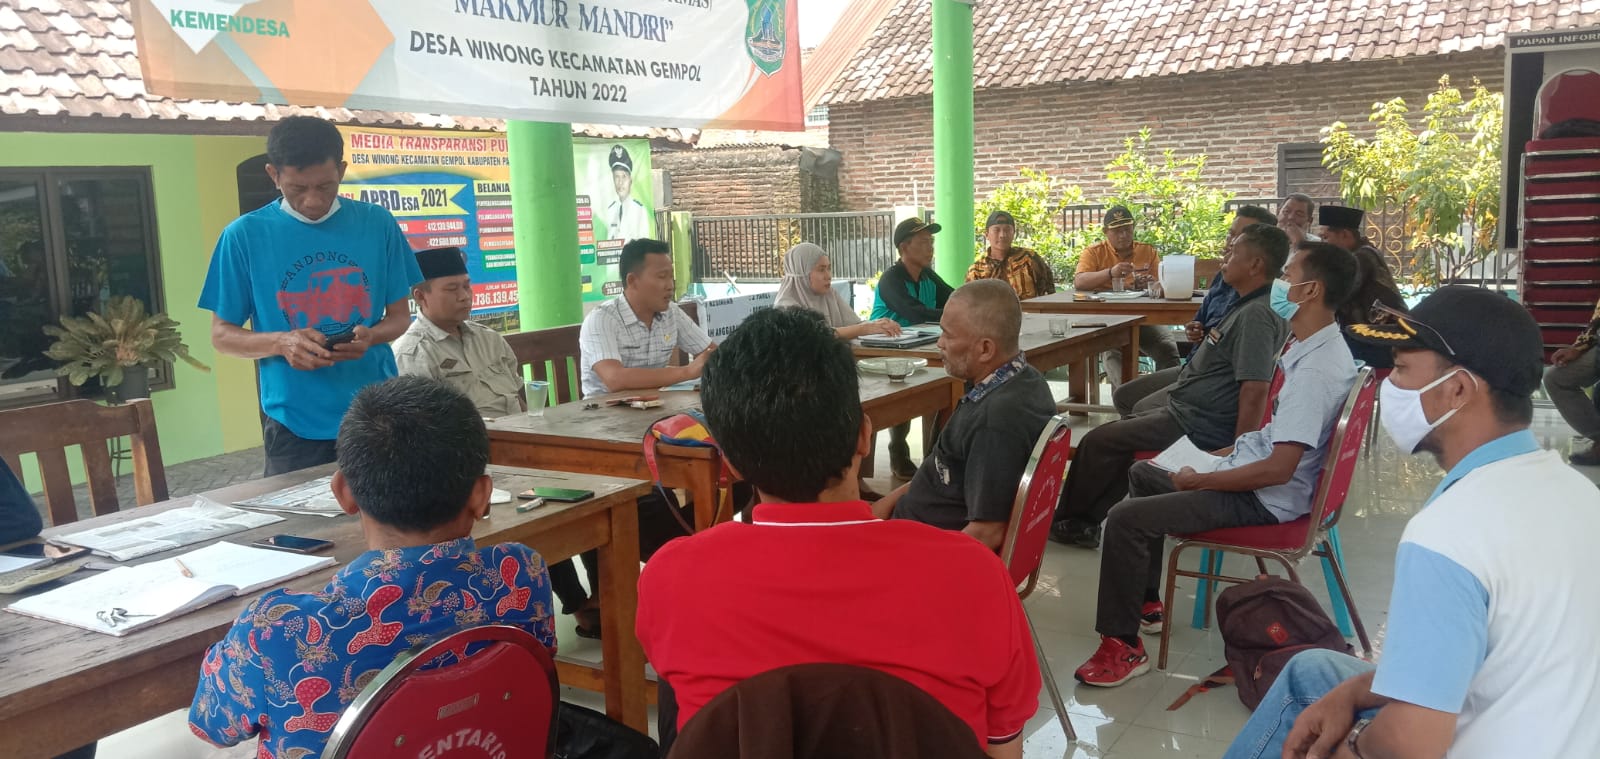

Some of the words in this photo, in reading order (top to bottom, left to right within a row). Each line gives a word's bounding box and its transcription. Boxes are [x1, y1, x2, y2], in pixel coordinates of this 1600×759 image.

[170, 9, 291, 38] KEMENDESA
[1516, 36, 1555, 46] PAPAN
[409, 30, 463, 57] DESA
[465, 38, 545, 66] WINONG
[548, 50, 648, 77] KECAMATAN
[650, 61, 701, 82] GEMPOL
[530, 76, 587, 100] TAHUN
[591, 82, 628, 103] 2022
[351, 133, 394, 150] MEDIA
[398, 135, 487, 152] TRANSPARANSI
[352, 153, 370, 164] DESA
[372, 154, 400, 165] WINONG
[401, 154, 440, 166] KECAMATAN
[441, 155, 466, 166] GEMPOL
[467, 156, 501, 166] KABUPATEN
[477, 182, 511, 193] BELANJA
[421, 188, 448, 207] 2021
